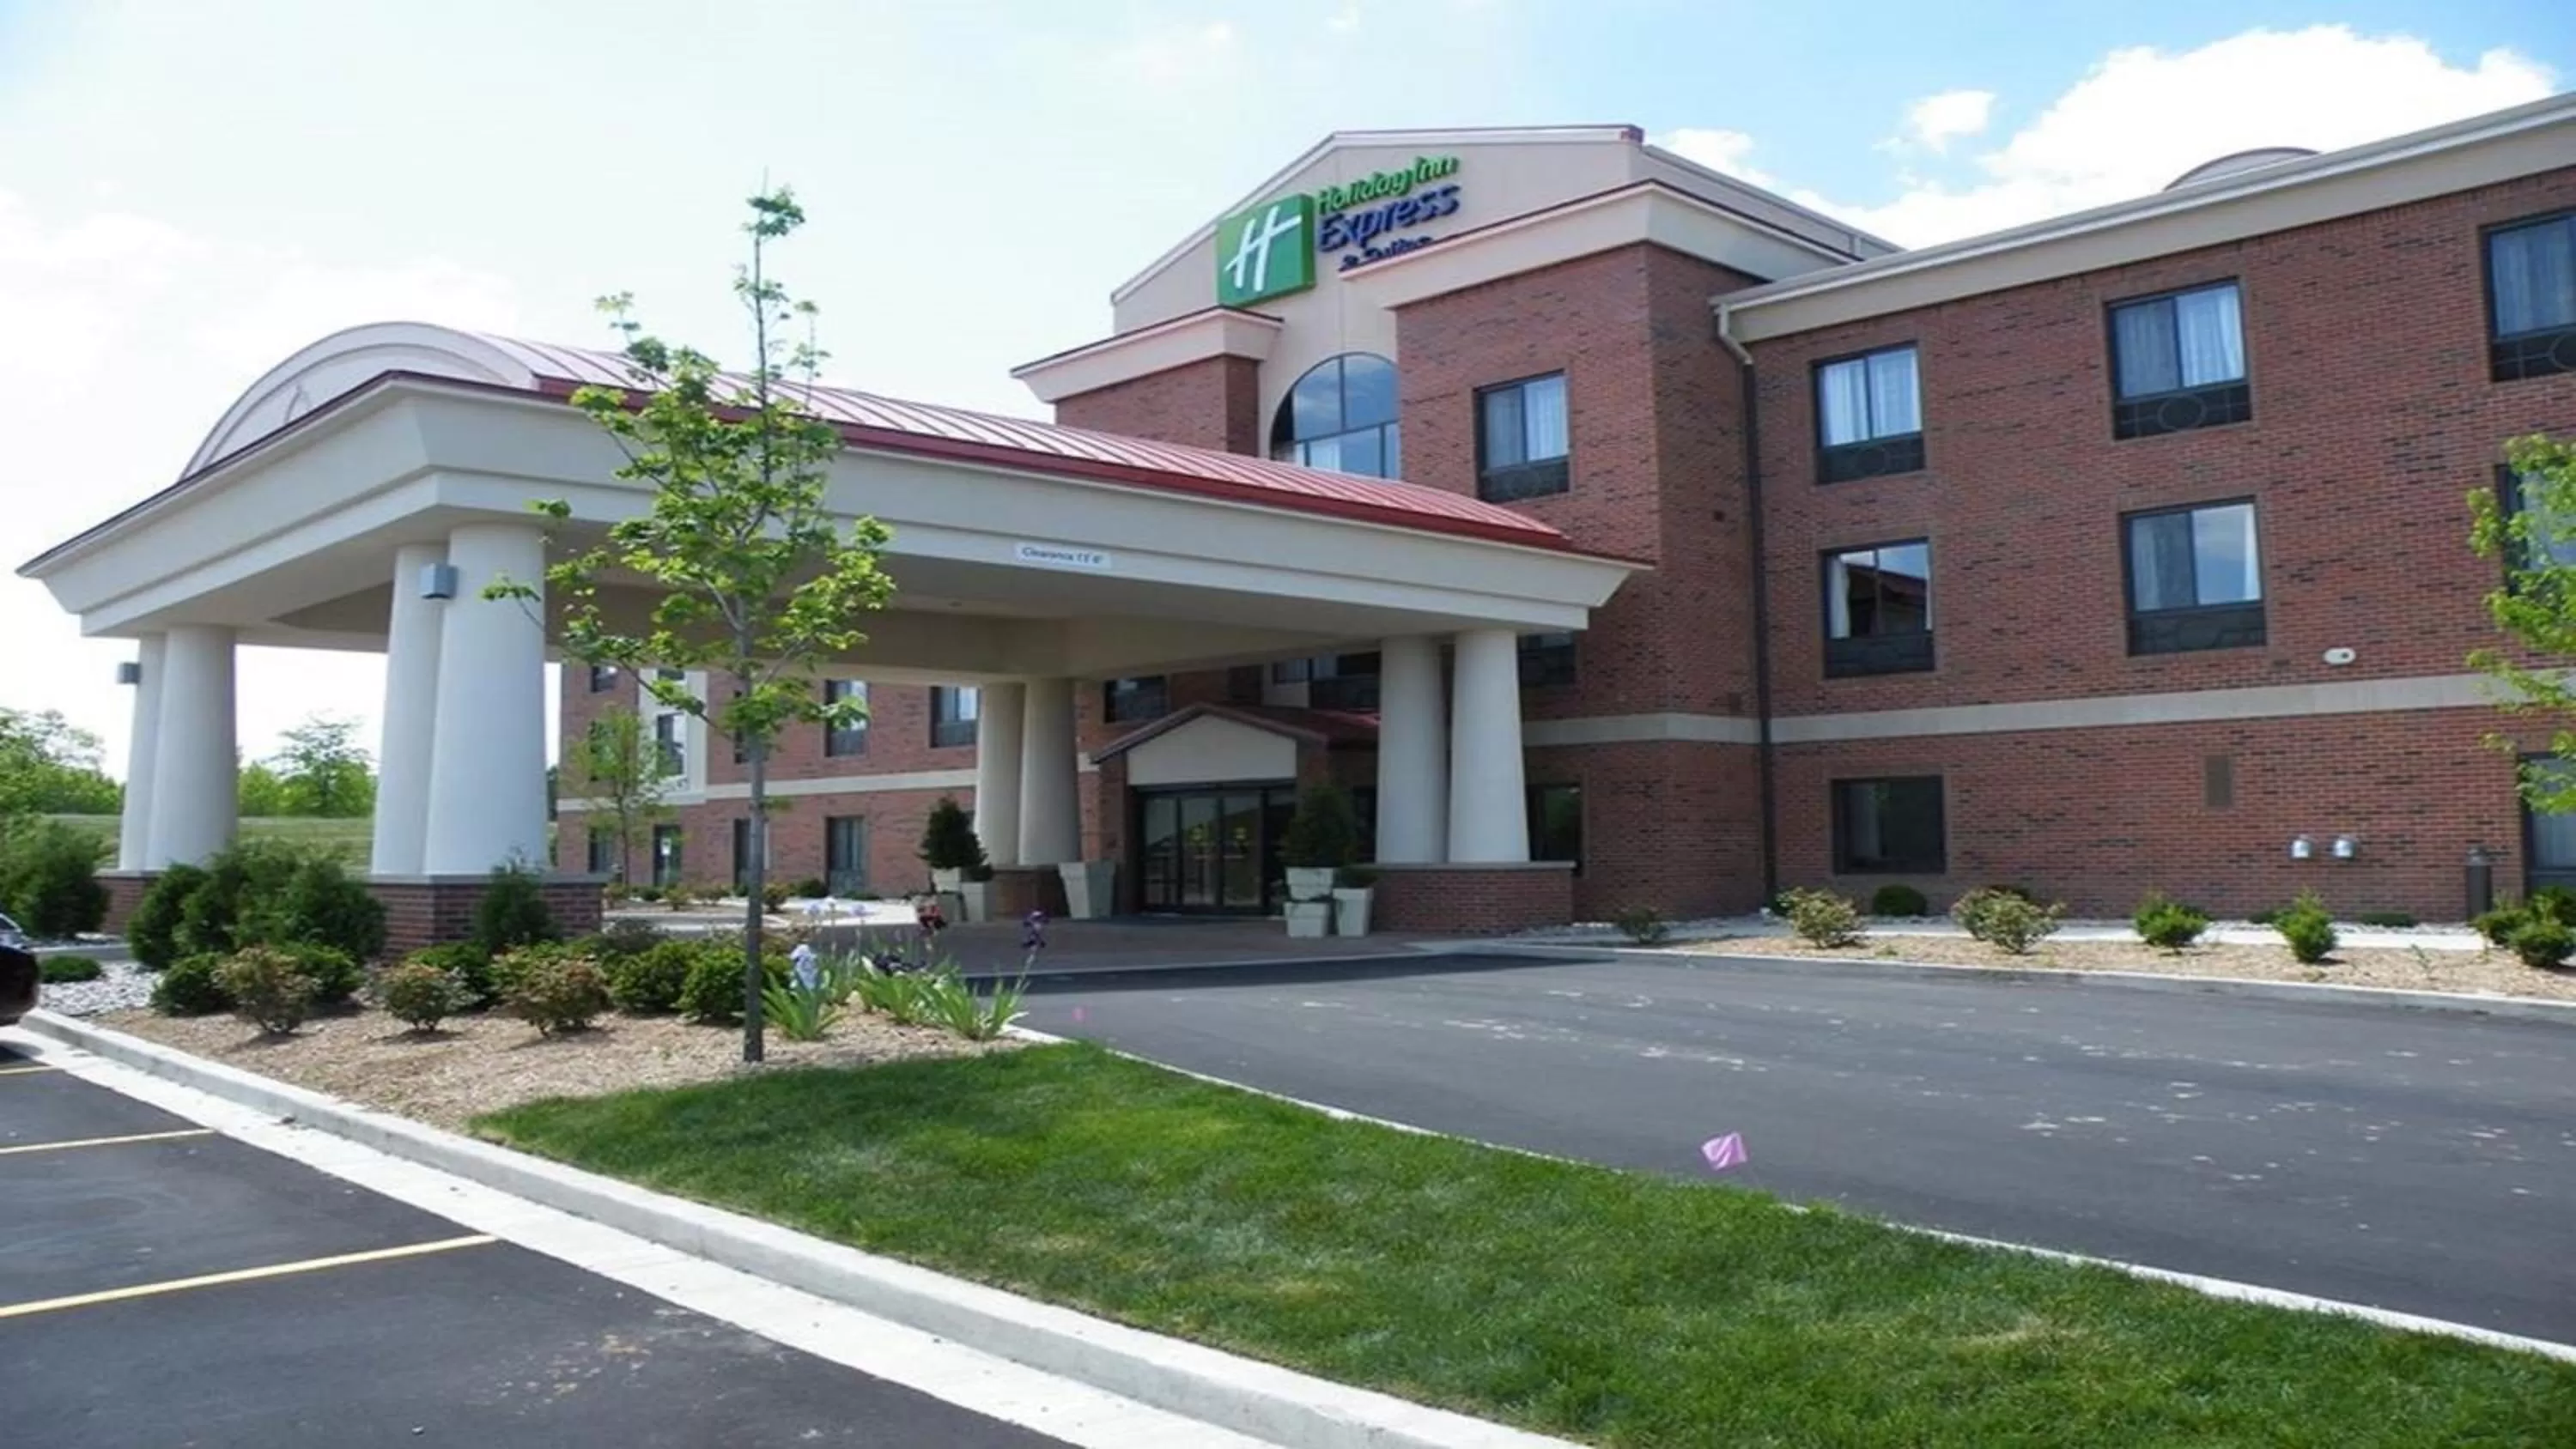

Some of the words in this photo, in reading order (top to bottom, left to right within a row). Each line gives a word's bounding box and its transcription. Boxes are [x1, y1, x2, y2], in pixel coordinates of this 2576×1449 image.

[1318, 169, 1413, 215] Holiday
[1414, 155, 1461, 183] Inn
[1320, 183, 1461, 252] Express
